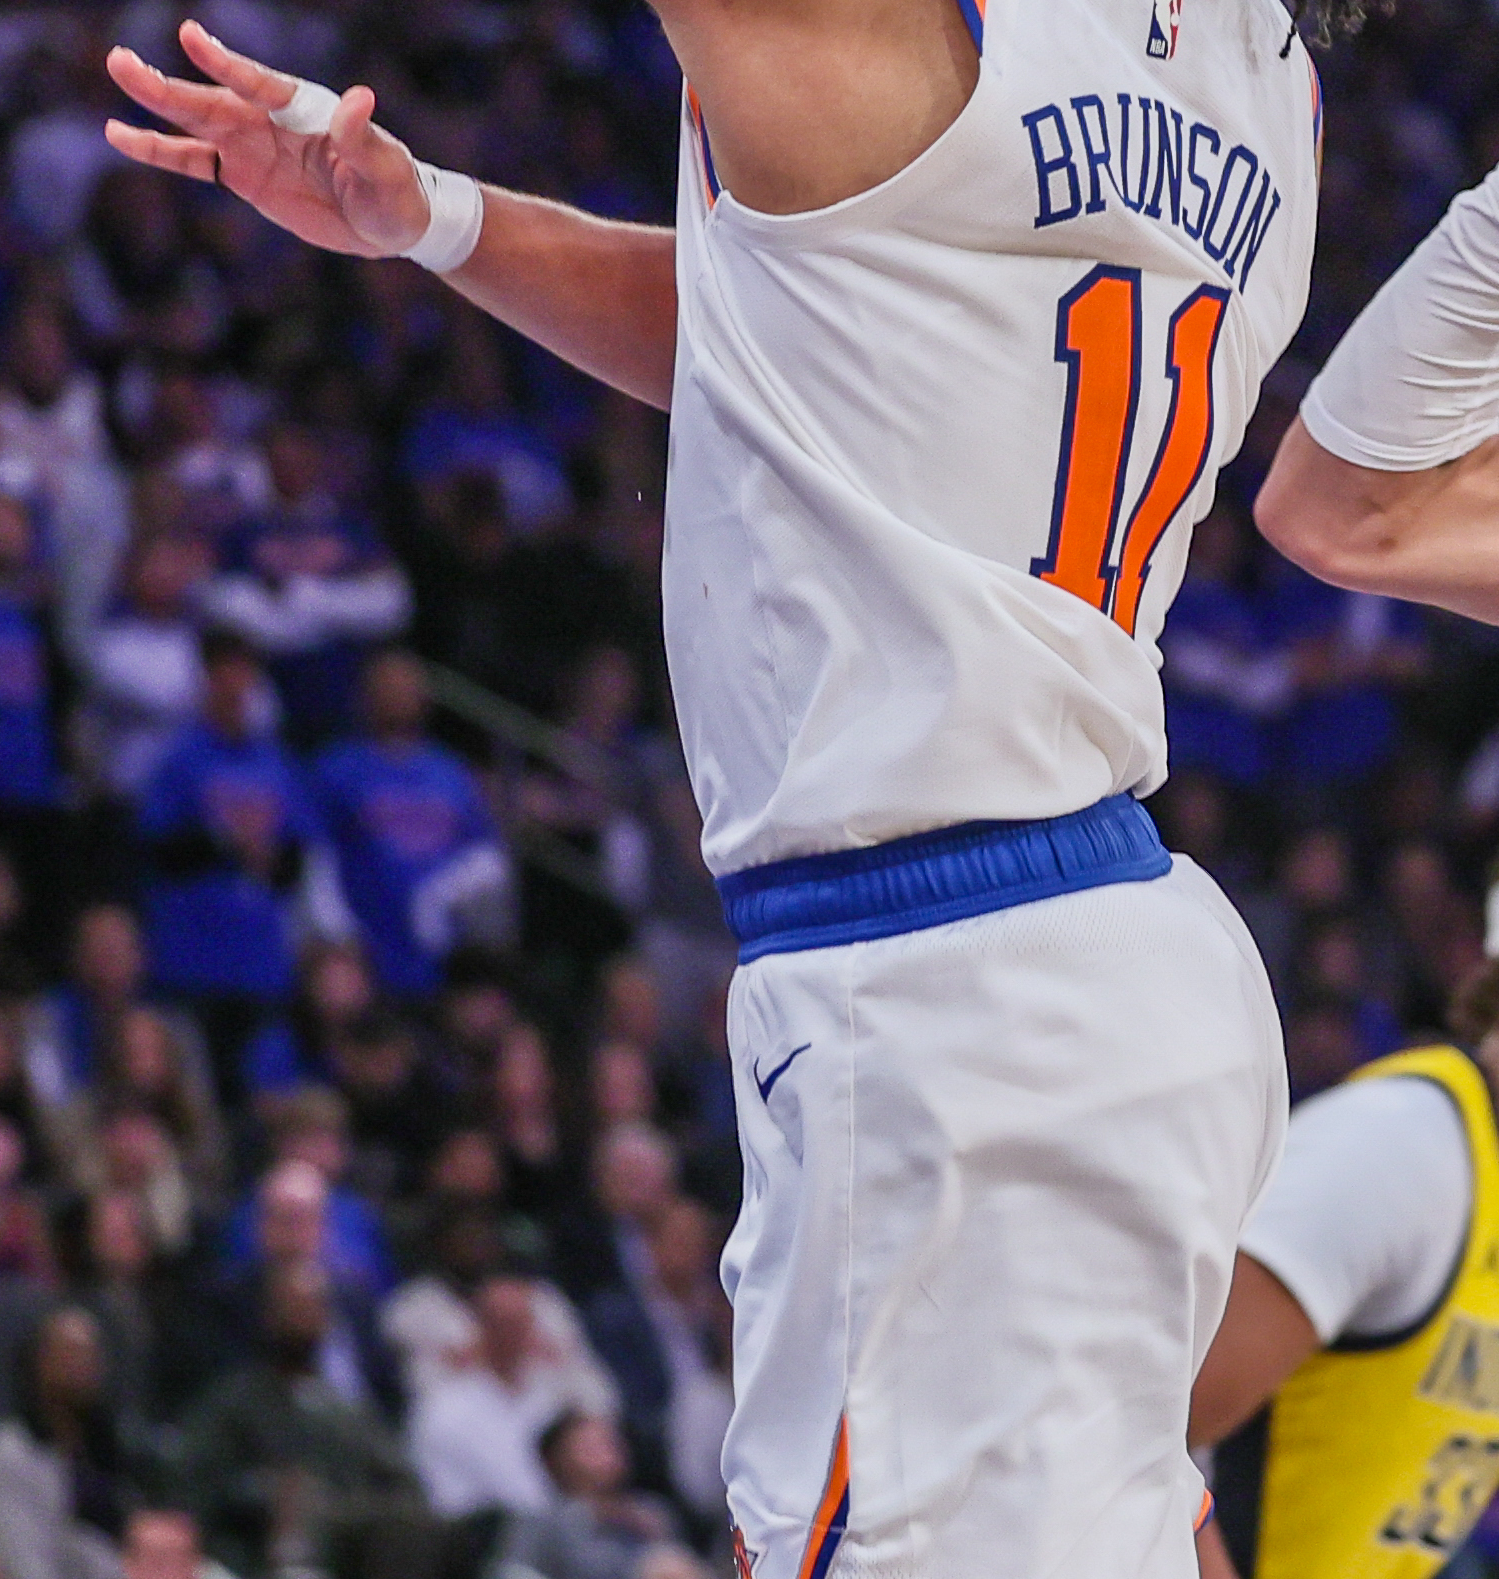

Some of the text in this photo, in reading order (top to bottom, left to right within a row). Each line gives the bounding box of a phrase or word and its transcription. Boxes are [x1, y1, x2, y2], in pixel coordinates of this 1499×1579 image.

[1149, 38, 1165, 55] NBA
[1021, 93, 1281, 296] BRUNSON
[1029, 263, 1232, 640] 11
